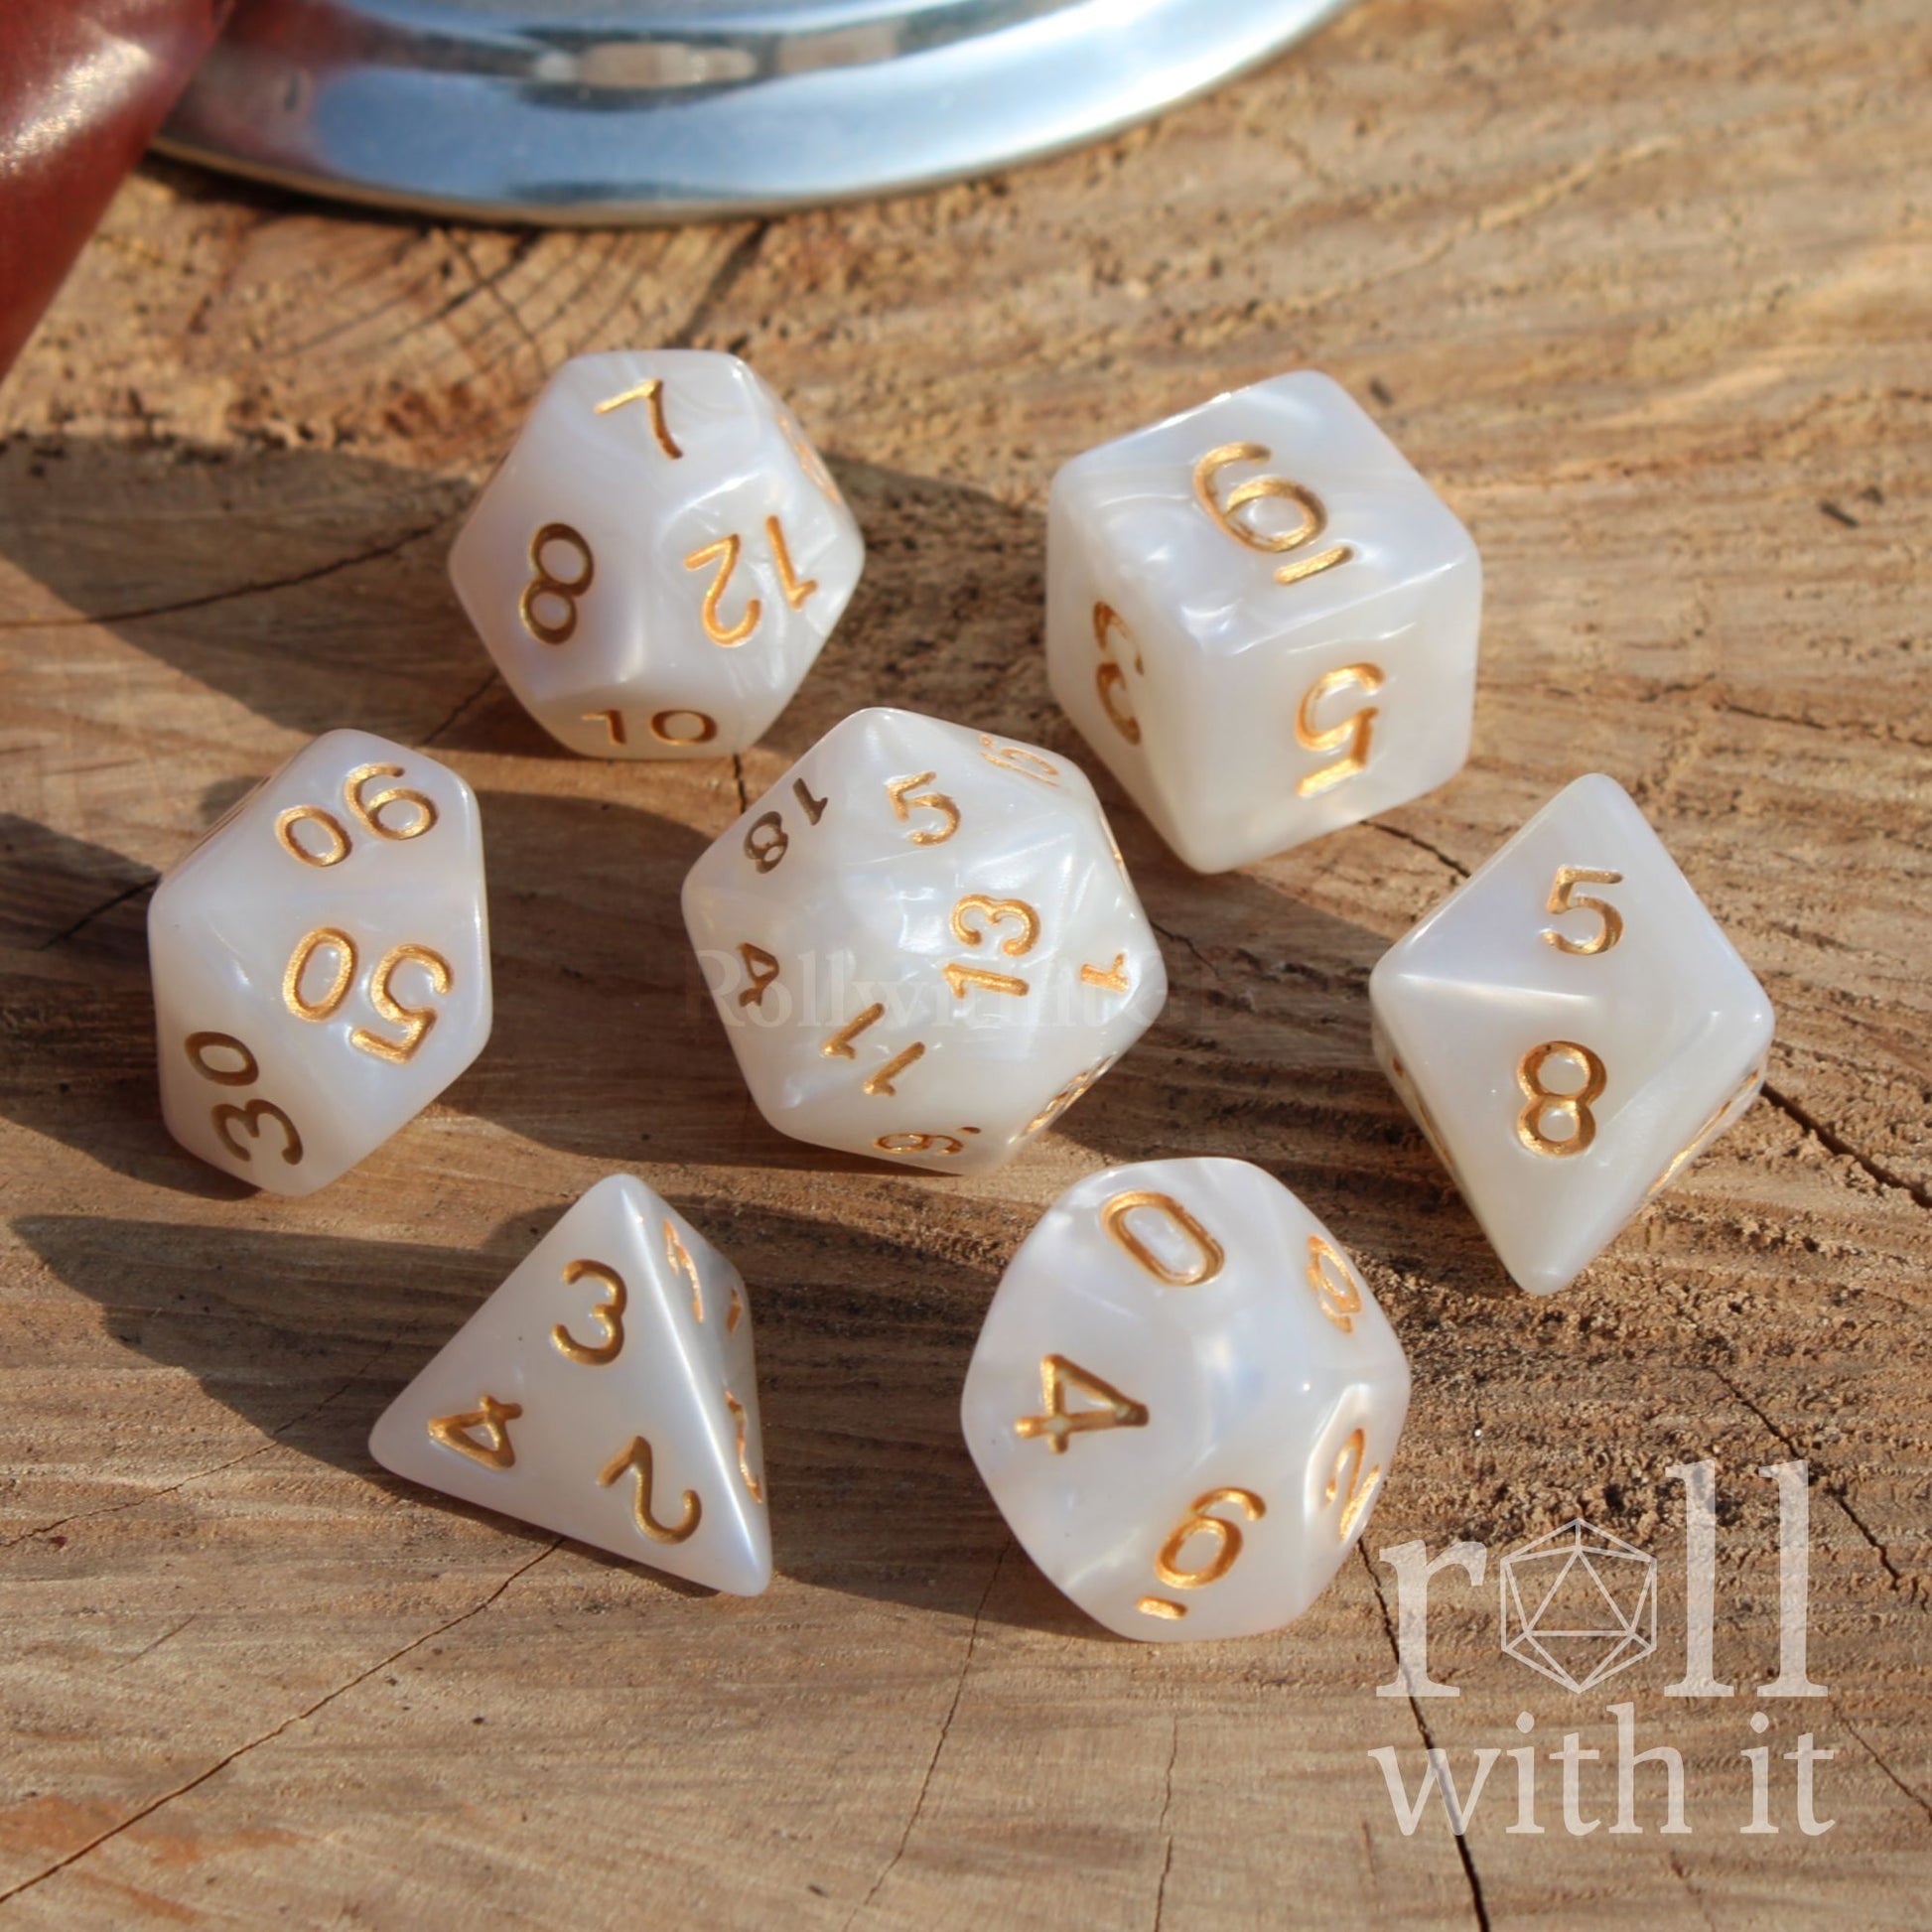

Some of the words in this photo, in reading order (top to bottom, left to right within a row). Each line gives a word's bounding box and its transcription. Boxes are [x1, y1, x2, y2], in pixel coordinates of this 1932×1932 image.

[594, 378, 683, 459] 7
[1194, 441, 1354, 587] 6
[520, 522, 595, 645] 8
[684, 514, 817, 648] 12
[1093, 601, 1145, 746] 3
[582, 709, 718, 747] 10
[1296, 662, 1385, 797] 5
[744, 777, 829, 874] 18
[886, 771, 961, 847] 5
[943, 893, 1040, 999] 13
[1543, 863, 1624, 955] 5
[282, 926, 453, 1064] 50
[738, 941, 780, 1007] 4
[185, 1031, 304, 1166] 30
[821, 1002, 925, 1096] 11
[1517, 1040, 1607, 1158] 8
[1100, 1190, 1224, 1286] 0
[550, 1259, 627, 1365] 3
[427, 1394, 522, 1470] 4
[1015, 1354, 1149, 1453] 4
[598, 1436, 702, 1545] 2
[1325, 1428, 1381, 1541] 2
[1136, 1486, 1266, 1619] 6
